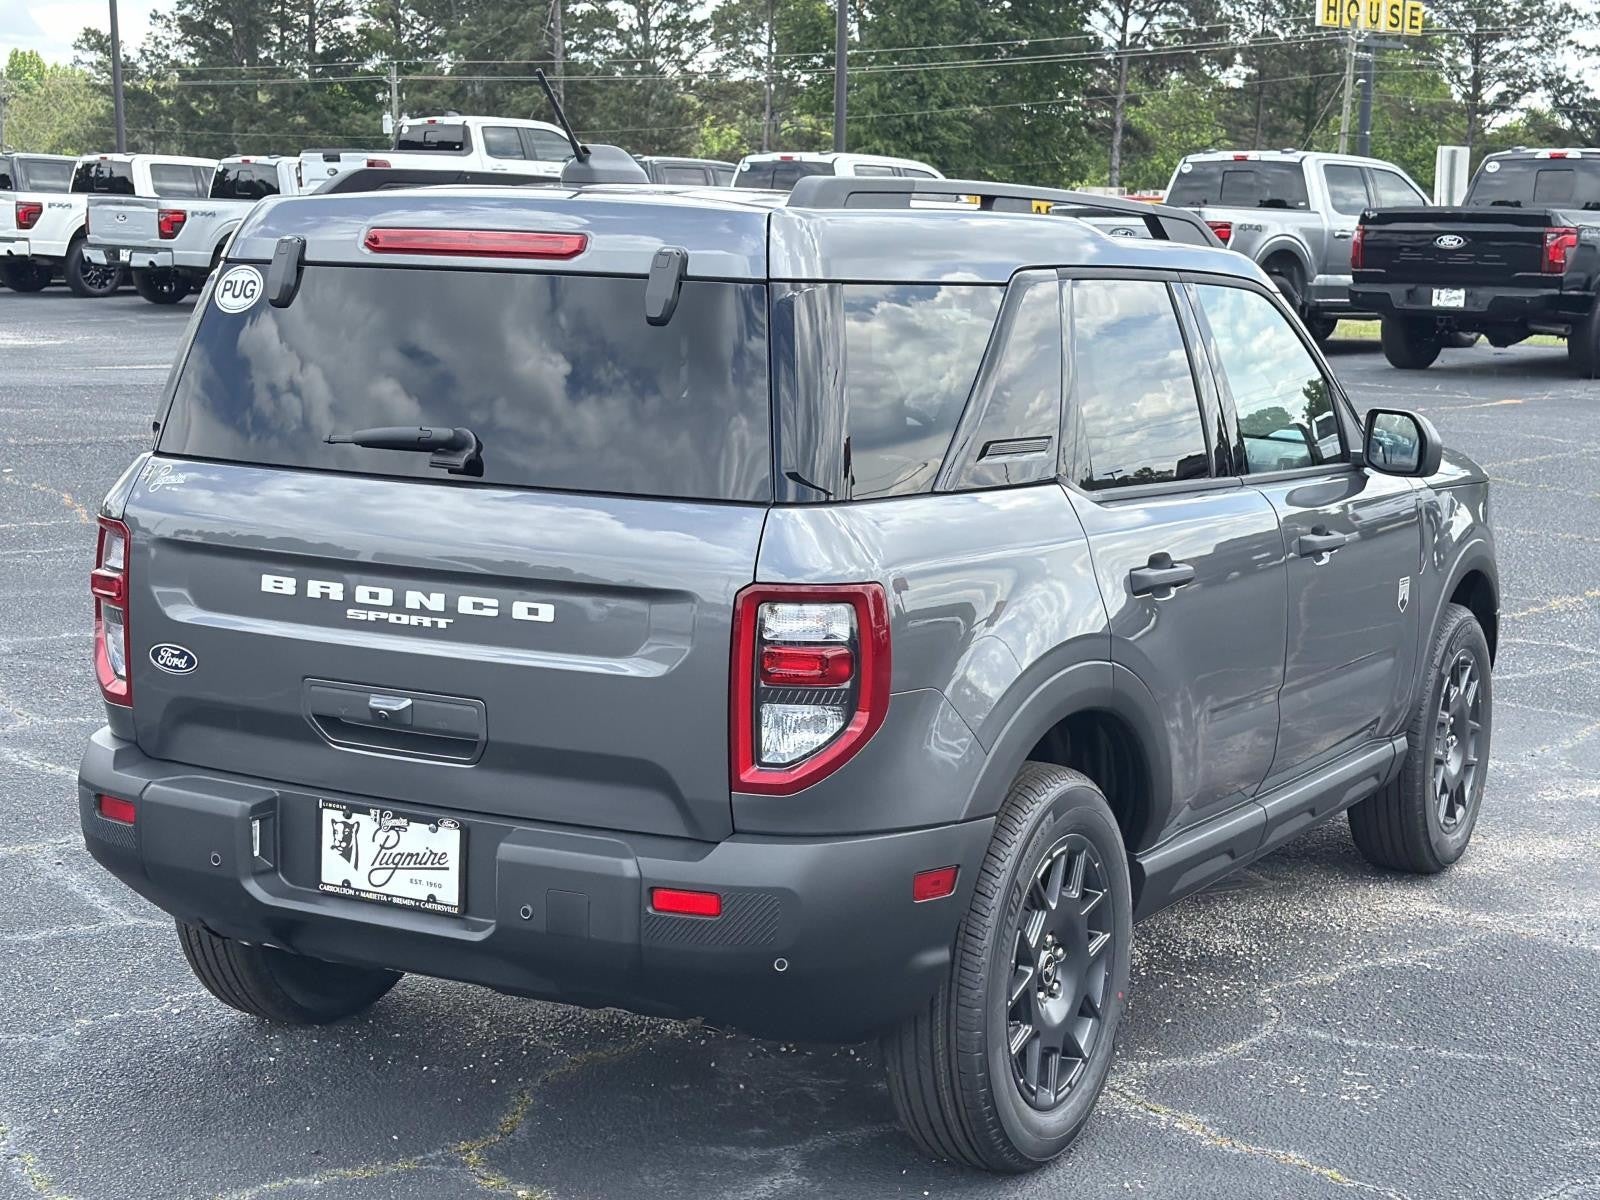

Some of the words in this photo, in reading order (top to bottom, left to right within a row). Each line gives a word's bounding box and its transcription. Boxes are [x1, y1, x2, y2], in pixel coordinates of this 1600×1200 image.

[1326, 0, 1420, 29] HOUSE
[221, 279, 257, 299] PUG
[260, 573, 556, 623] BRONCO
[346, 608, 454, 629] SPORT
[158, 647, 188, 669] Ford
[368, 827, 450, 888] Pugmire
[409, 878, 424, 886] EST.
[360, 890, 388, 902] MARIETTA
[392, 896, 415, 907] BREMEN
[420, 901, 459, 914] CARTERSVILLE
